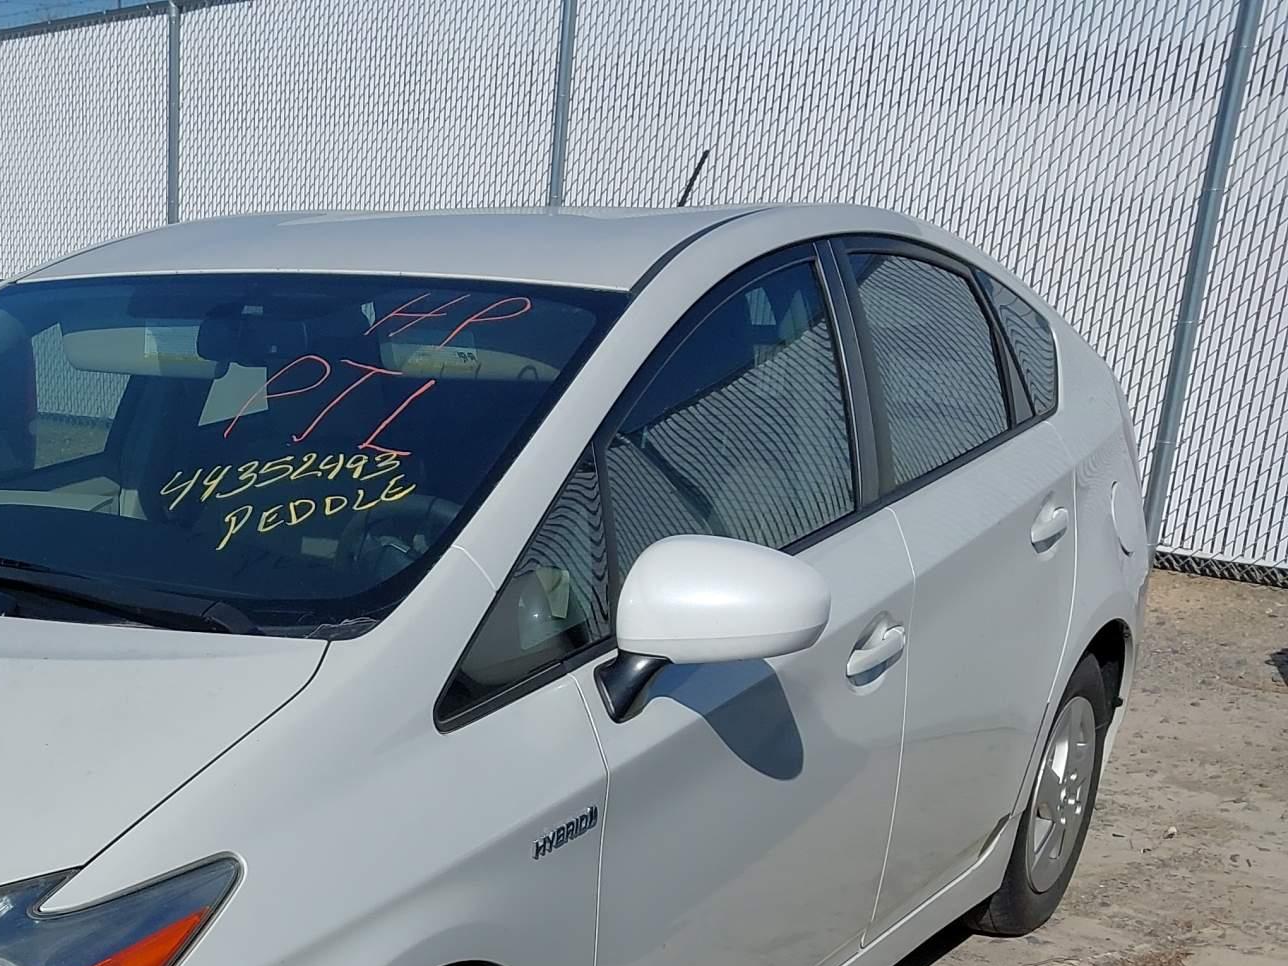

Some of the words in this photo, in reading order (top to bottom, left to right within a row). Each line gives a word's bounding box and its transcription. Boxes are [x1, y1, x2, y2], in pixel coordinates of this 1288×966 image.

[160, 453, 401, 511] 44352493
[216, 474, 416, 551] PEDDLE
[532, 813, 589, 860] HYBRID
